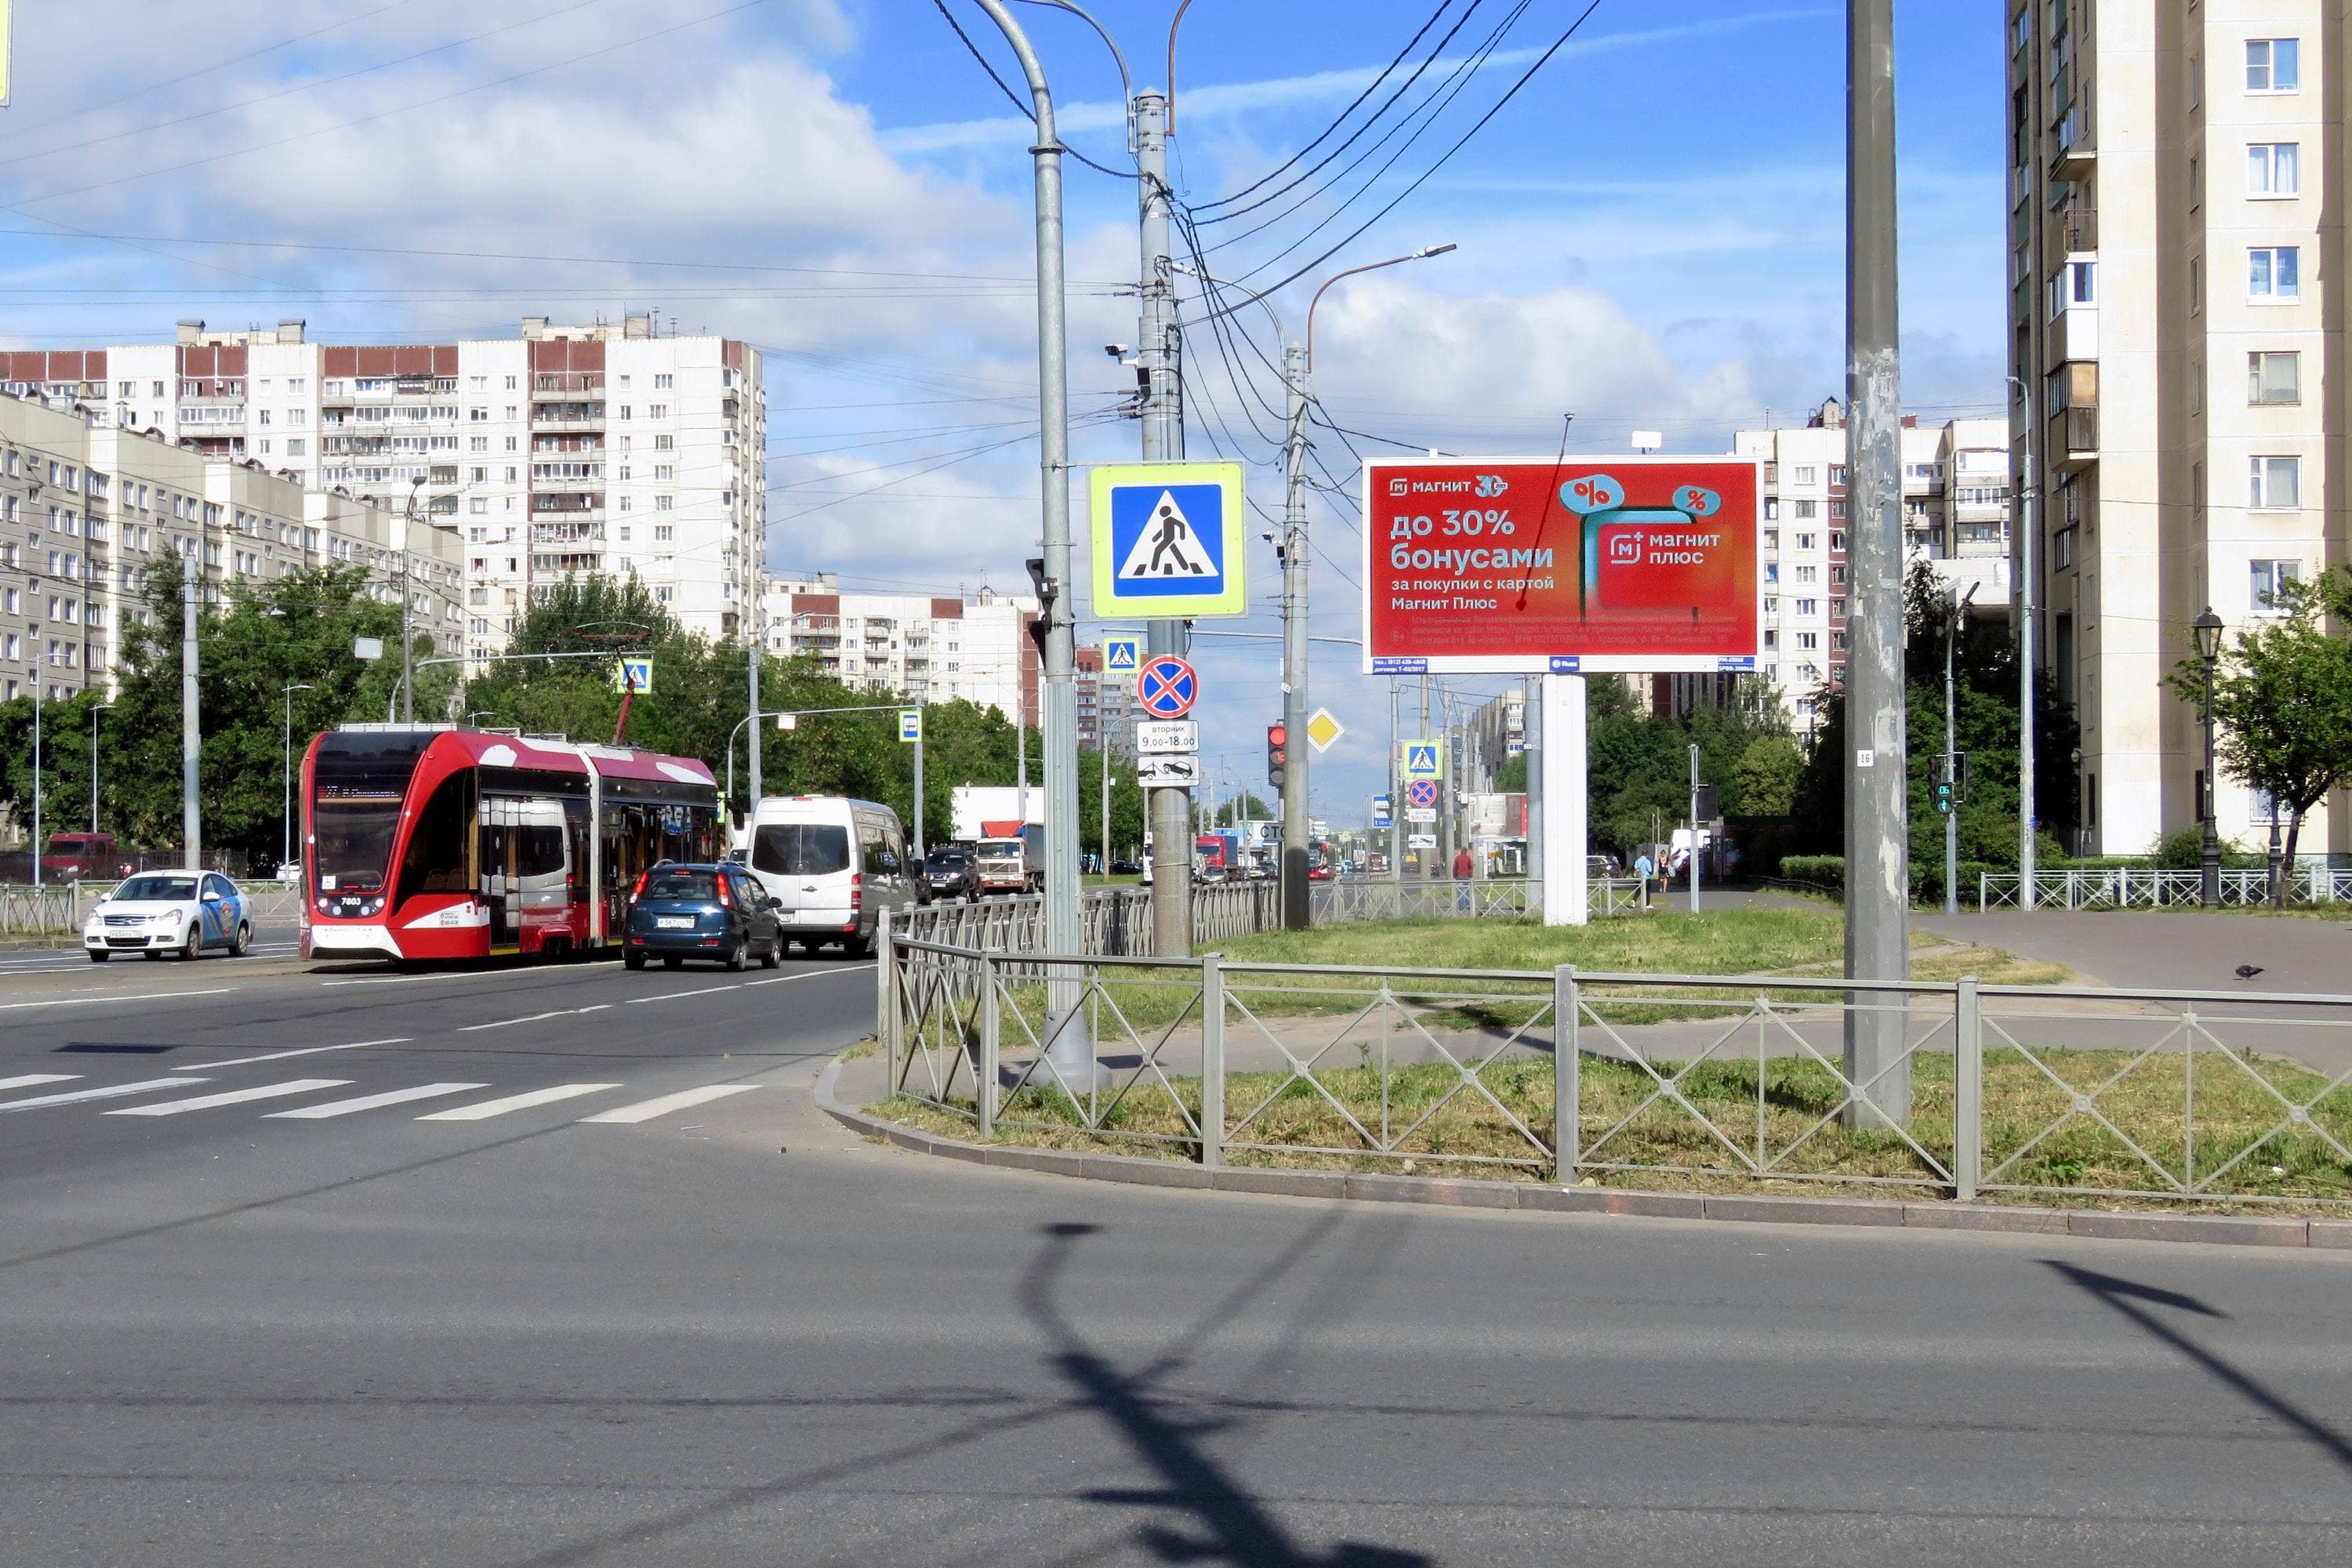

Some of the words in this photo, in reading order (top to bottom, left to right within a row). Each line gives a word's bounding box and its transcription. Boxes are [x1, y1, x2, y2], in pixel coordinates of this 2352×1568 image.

[1413, 481, 1472, 492] МАГНИТ
[1390, 515, 1432, 539] до
[1442, 510, 1515, 535] 30%
[1650, 535, 1720, 547] магнит
[1391, 543, 1553, 575] бонусами
[1650, 552, 1704, 564] плюс
[1392, 580, 1410, 590] за
[1414, 579, 1479, 593] покупки
[1483, 579, 1493, 590] с
[1497, 576, 1554, 592] картой
[1392, 597, 1449, 609] Магнит
[1453, 597, 1497, 609] Плюс
[341, 897, 361, 906] 7803
